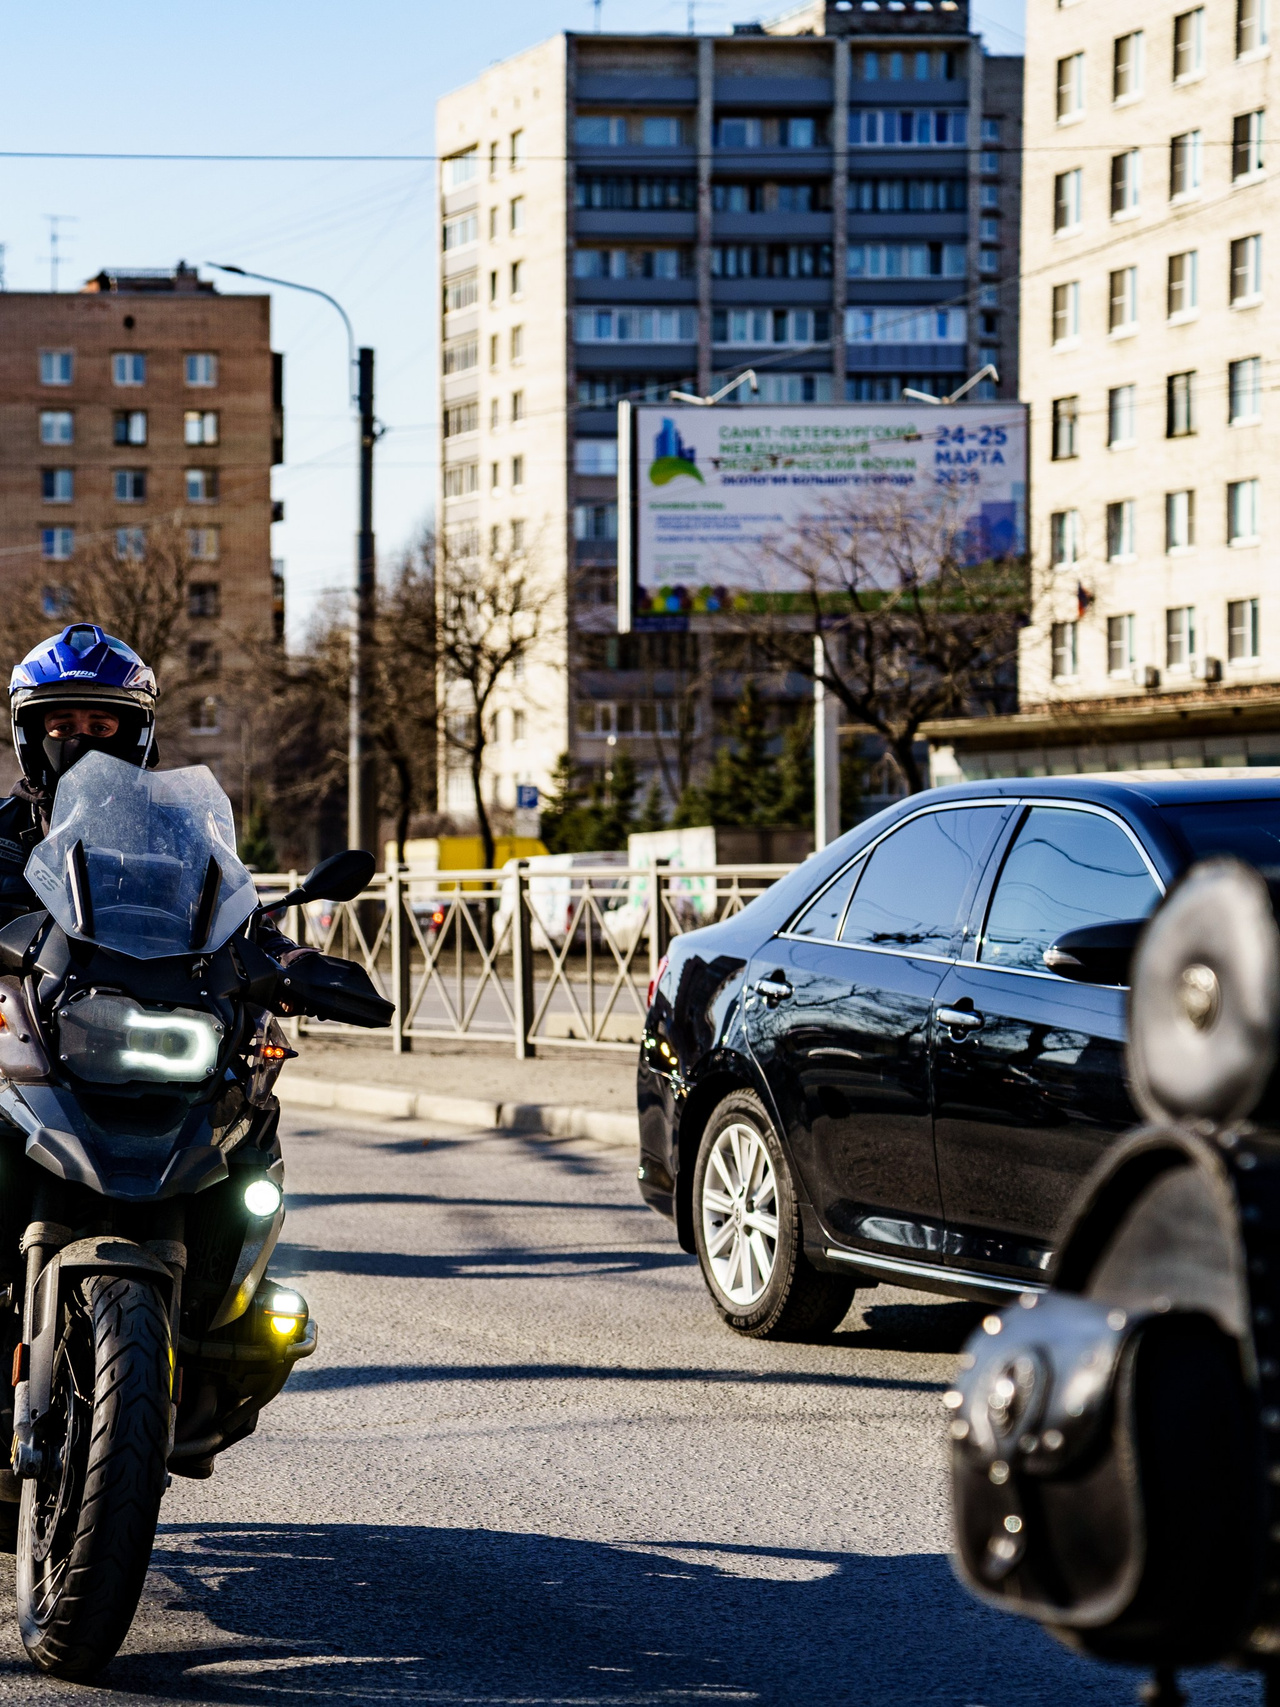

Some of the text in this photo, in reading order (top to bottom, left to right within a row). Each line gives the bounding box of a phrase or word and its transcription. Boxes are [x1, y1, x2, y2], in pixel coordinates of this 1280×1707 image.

[935, 425, 1008, 446] 24-25
[934, 450, 1006, 466] МАРТА
[59, 670, 98, 679] NOLAN
[33, 869, 60, 892] GS
